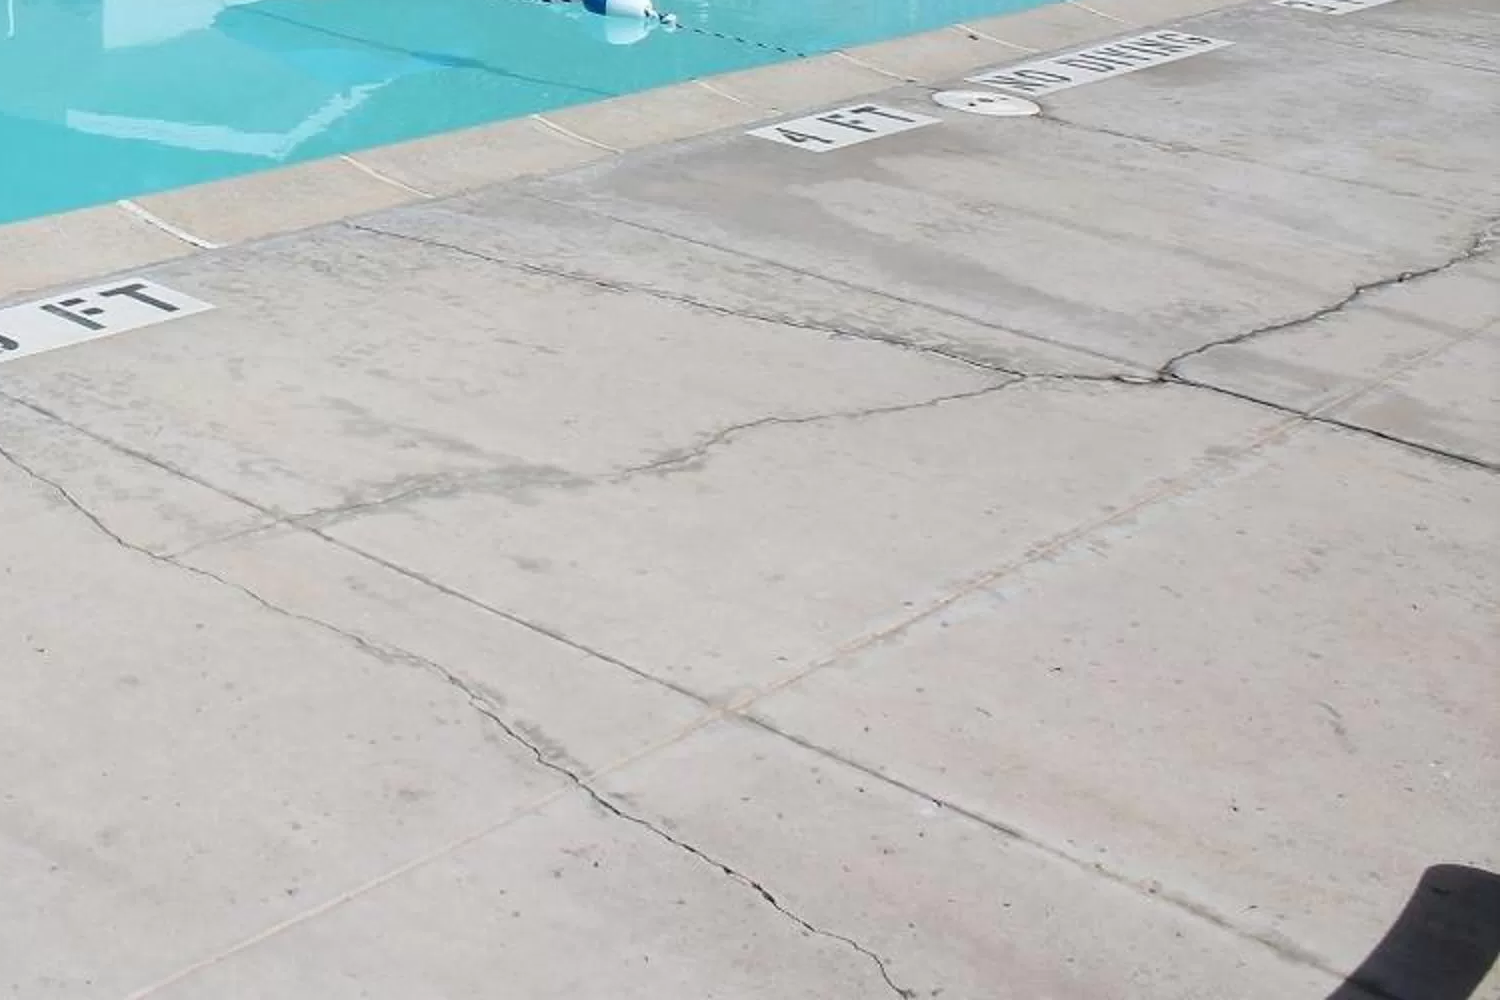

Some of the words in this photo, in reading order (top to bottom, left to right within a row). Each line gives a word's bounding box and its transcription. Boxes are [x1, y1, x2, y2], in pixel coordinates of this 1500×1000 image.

[997, 68, 1072, 93] NO
[1060, 30, 1215, 74] DIVING
[775, 126, 833, 145] 4
[817, 103, 917, 133] FT
[39, 282, 181, 331] FT
